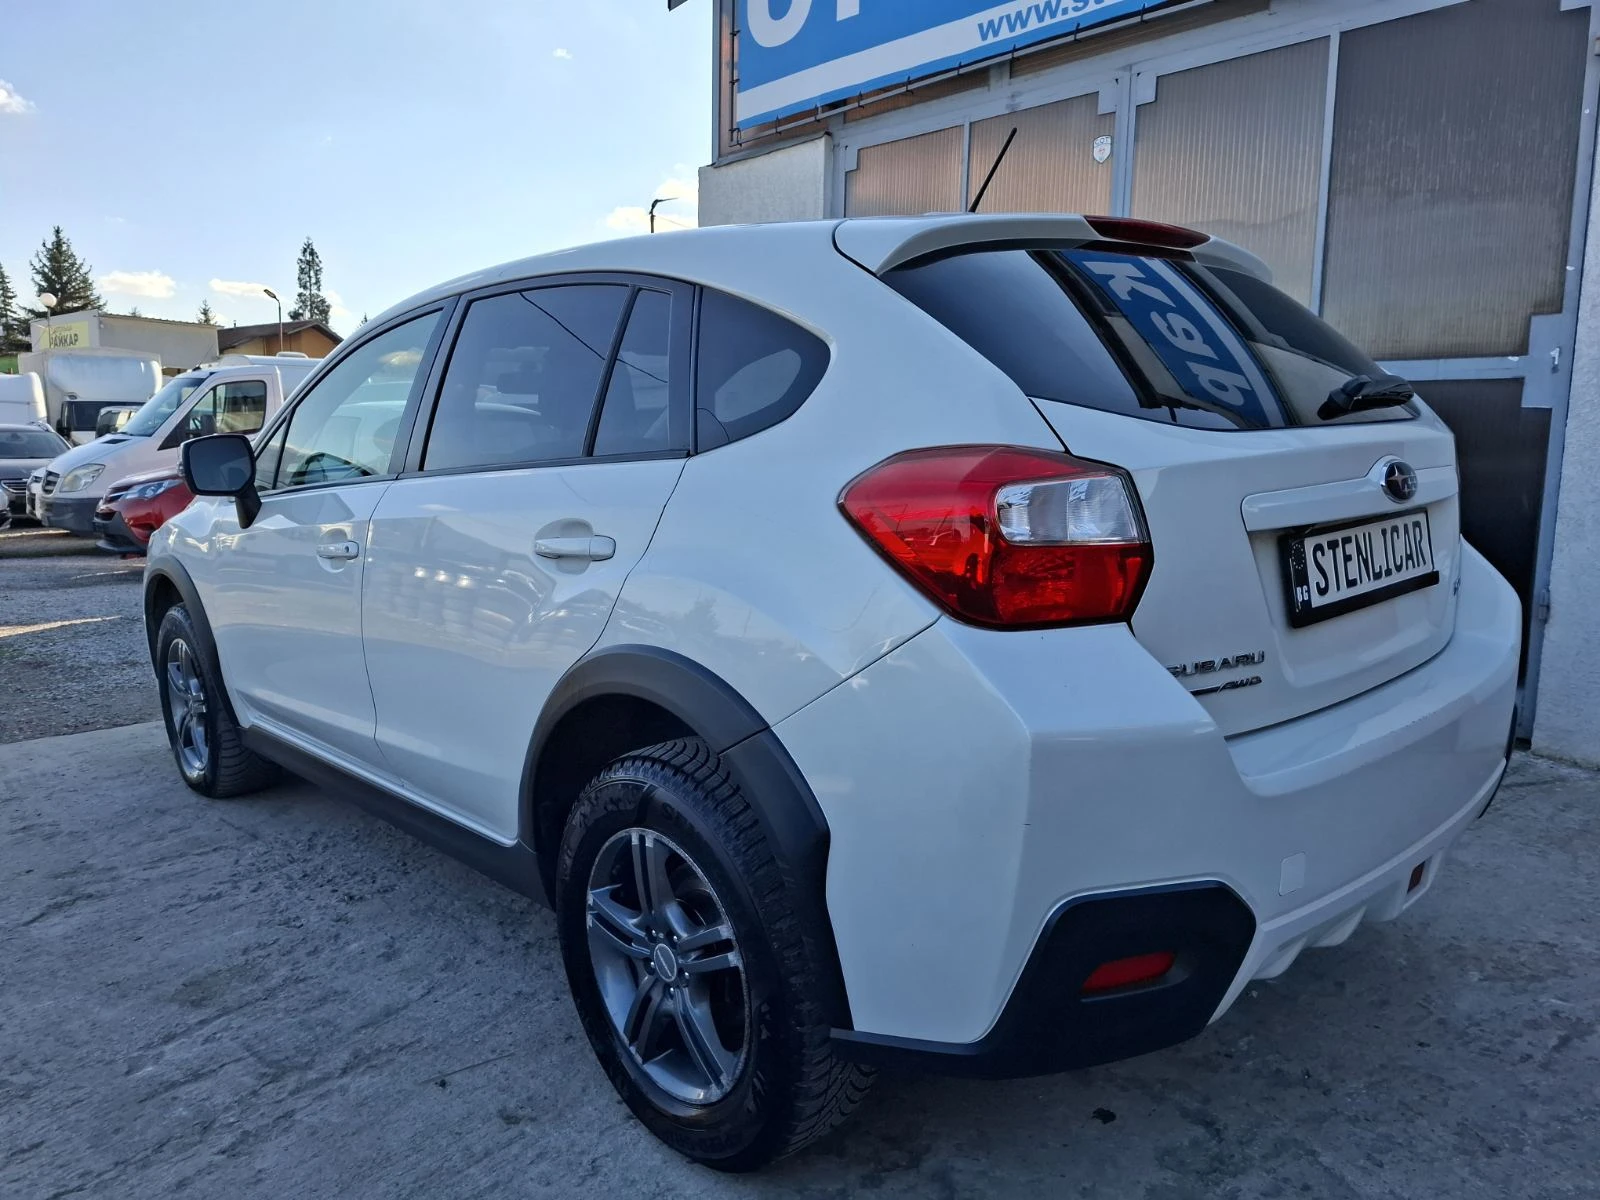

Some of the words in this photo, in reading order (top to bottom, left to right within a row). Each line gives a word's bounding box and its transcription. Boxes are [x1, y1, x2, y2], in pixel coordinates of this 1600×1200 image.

[977, 0, 1105, 42] www.s
[1312, 520, 1427, 597] STENLICAR
[1296, 585, 1309, 602] BG
[1219, 676, 1262, 691] AWD
